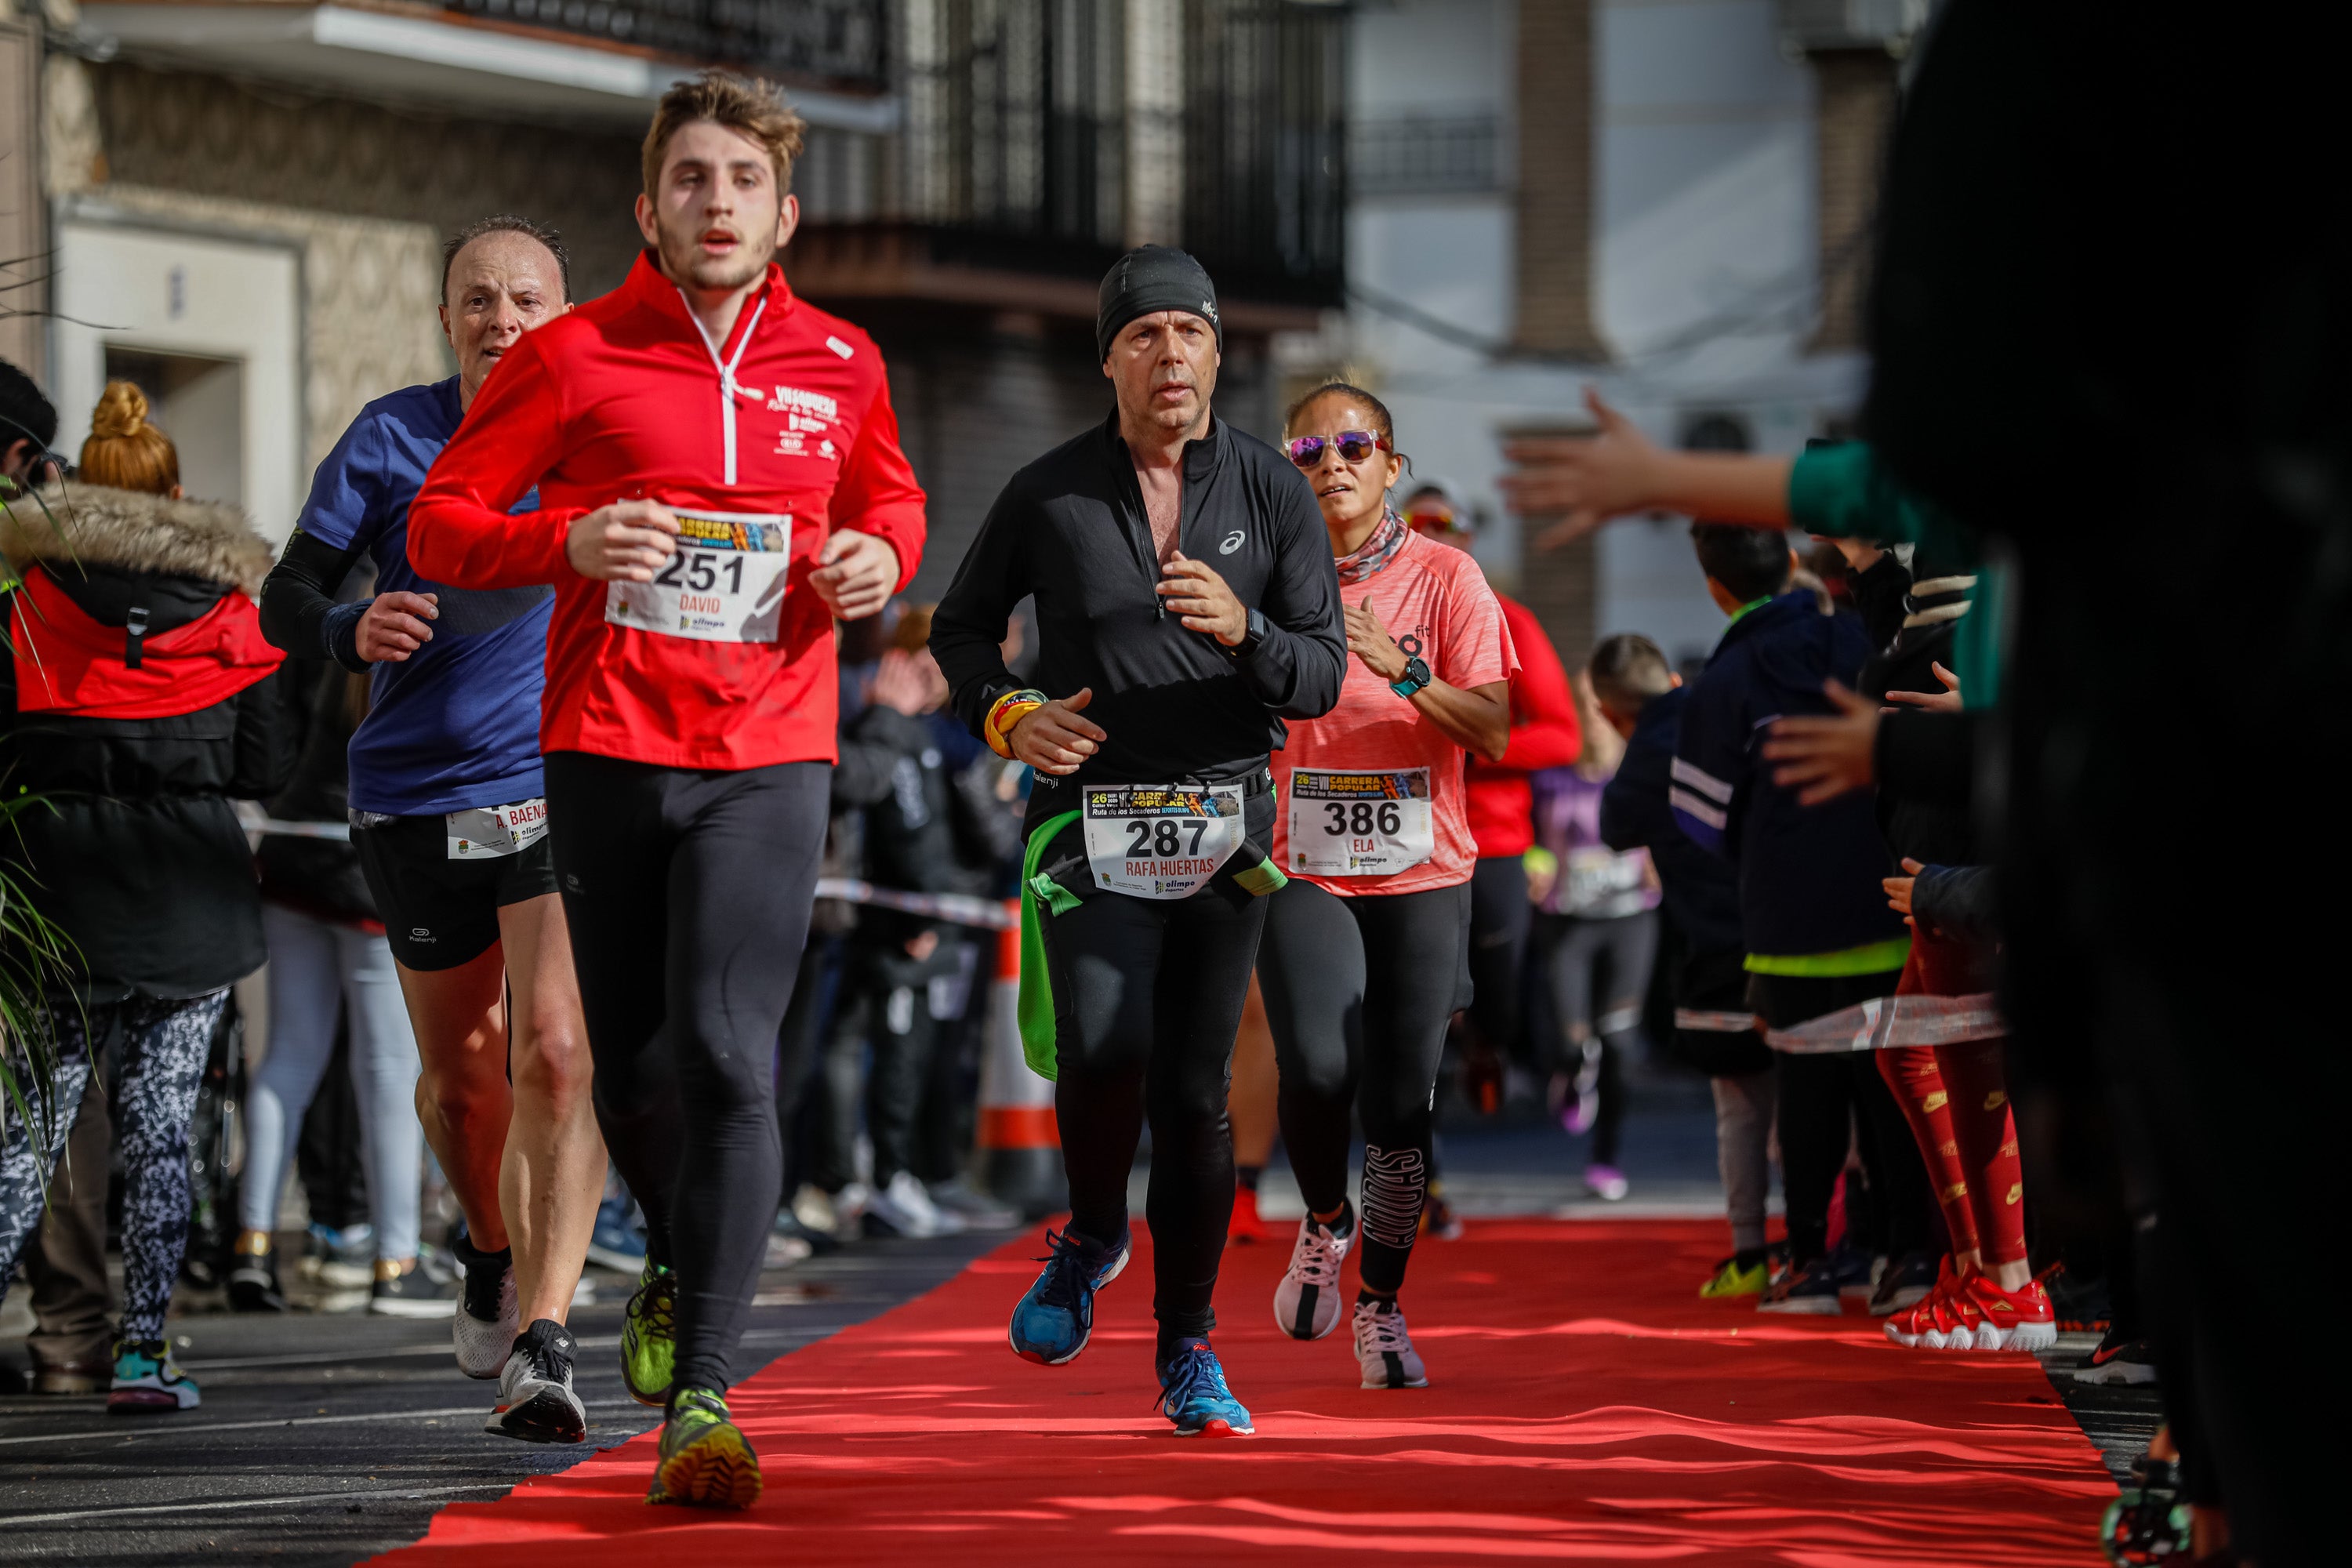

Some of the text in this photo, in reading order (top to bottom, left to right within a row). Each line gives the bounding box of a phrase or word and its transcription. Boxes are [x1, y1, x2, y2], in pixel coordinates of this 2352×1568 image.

[655, 550, 744, 595] 251
[679, 594, 720, 615] DAVID
[1415, 624, 1431, 638] fit
[1297, 774, 1309, 785] 26
[1319, 776, 1330, 790] VII
[1330, 776, 1381, 785] CARRERA
[1091, 793, 1107, 804] 26
[1133, 792, 1185, 801] CARREA
[495, 803, 548, 829] A. BAENA
[1323, 802, 1401, 837] 386
[1126, 819, 1208, 858] 287
[1353, 839, 1374, 852] ELA
[1359, 855, 1388, 865] olimpo
[1126, 858, 1214, 877] RAFA HUERTAS
[1166, 880, 1196, 889] olimpo
